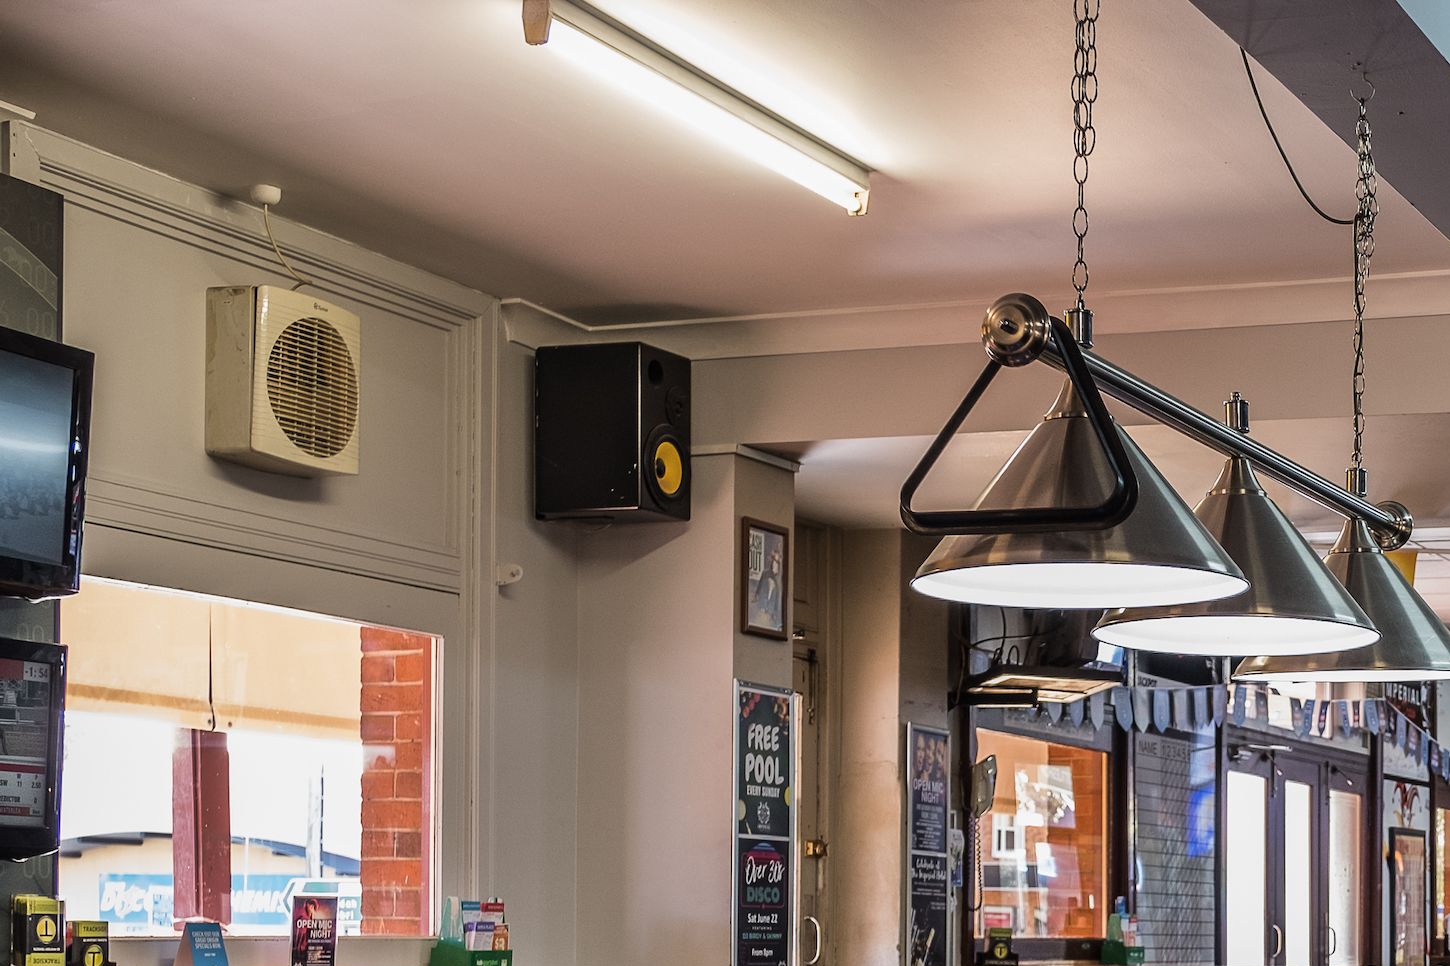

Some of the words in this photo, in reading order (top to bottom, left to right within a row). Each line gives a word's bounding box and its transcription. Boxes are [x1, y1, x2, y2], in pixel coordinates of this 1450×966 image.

[748, 723, 780, 752] FREE
[745, 752, 784, 785] POOL
[745, 856, 767, 885] Over
[746, 886, 780, 903] DISCO
[297, 919, 318, 929] OPEN
[318, 919, 333, 929] MIC
[747, 913, 757, 923] Sat
[758, 914, 770, 924] June
[771, 913, 778, 924] 22
[310, 930, 331, 939] NIGHT
